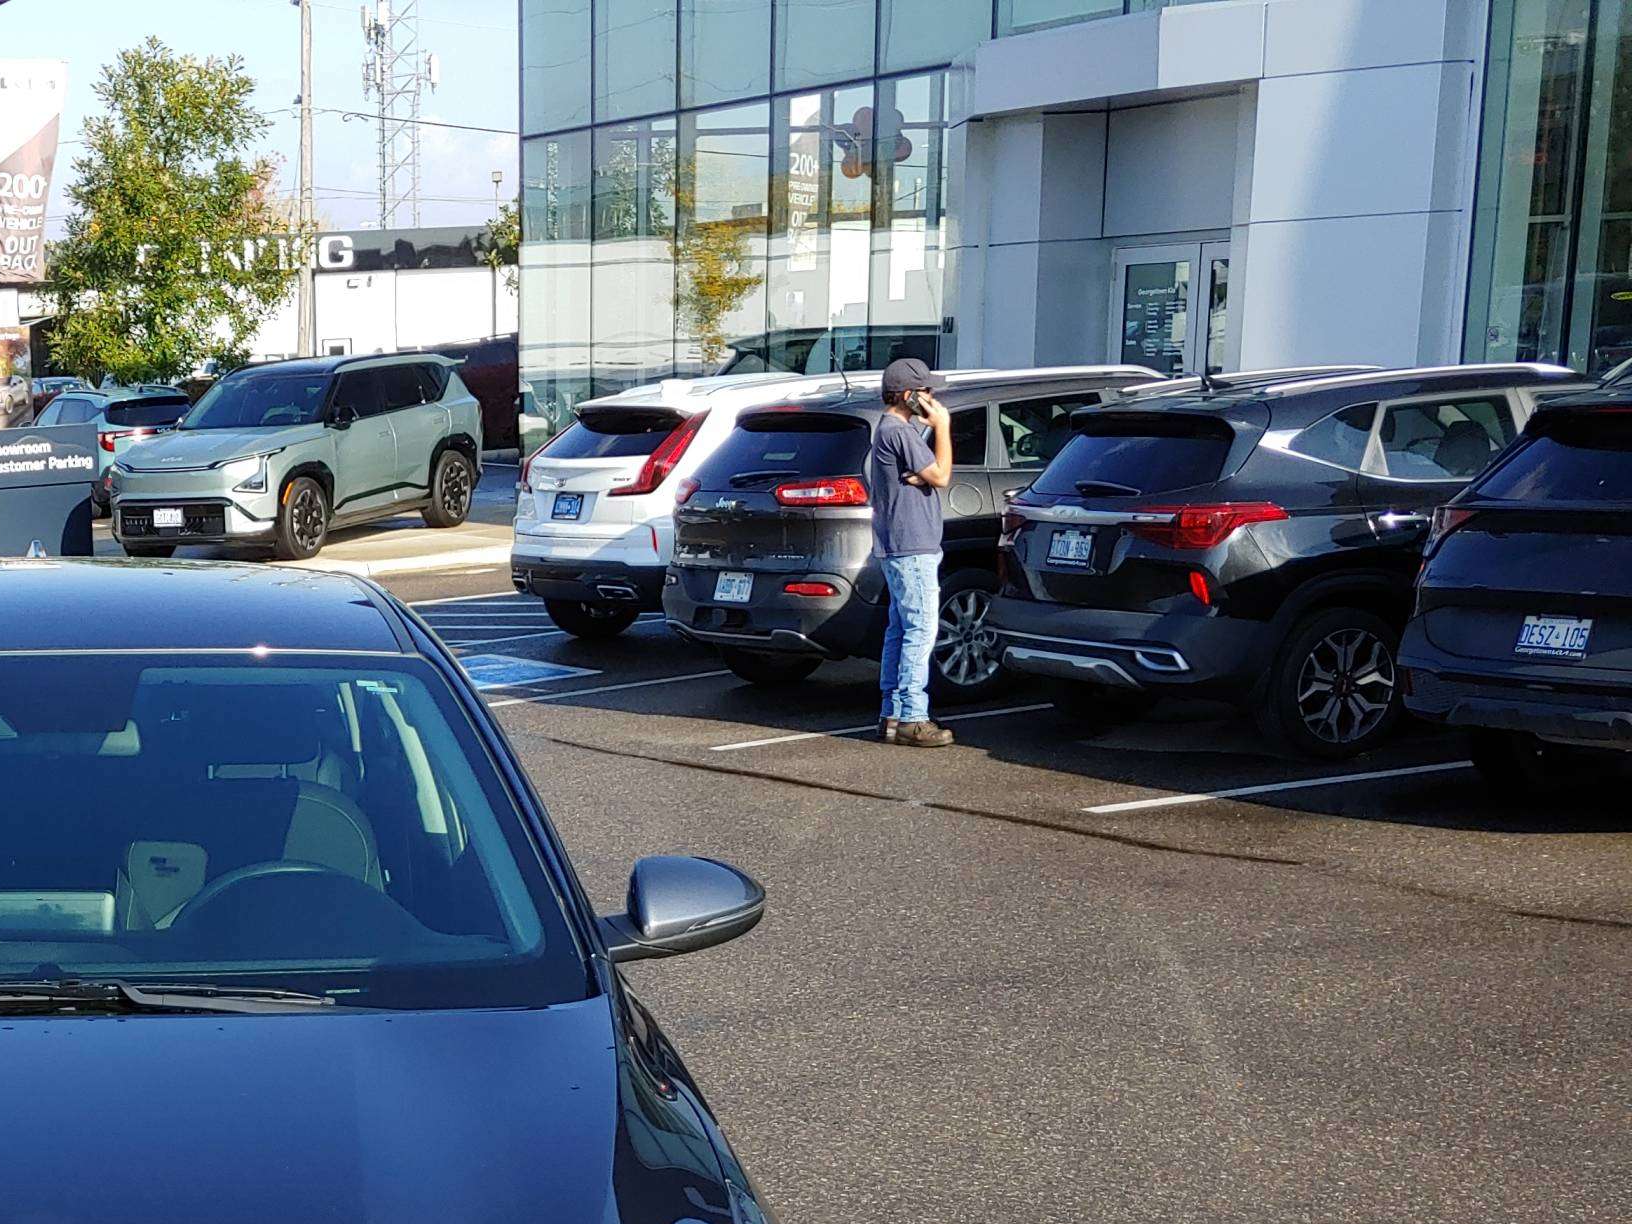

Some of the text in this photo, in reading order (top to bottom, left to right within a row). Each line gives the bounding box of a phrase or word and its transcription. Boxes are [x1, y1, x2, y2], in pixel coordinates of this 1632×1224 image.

[5, 235, 39, 255] OUT
[48, 455, 93, 470] Parking
[1518, 623, 1589, 648] DESZ 105
